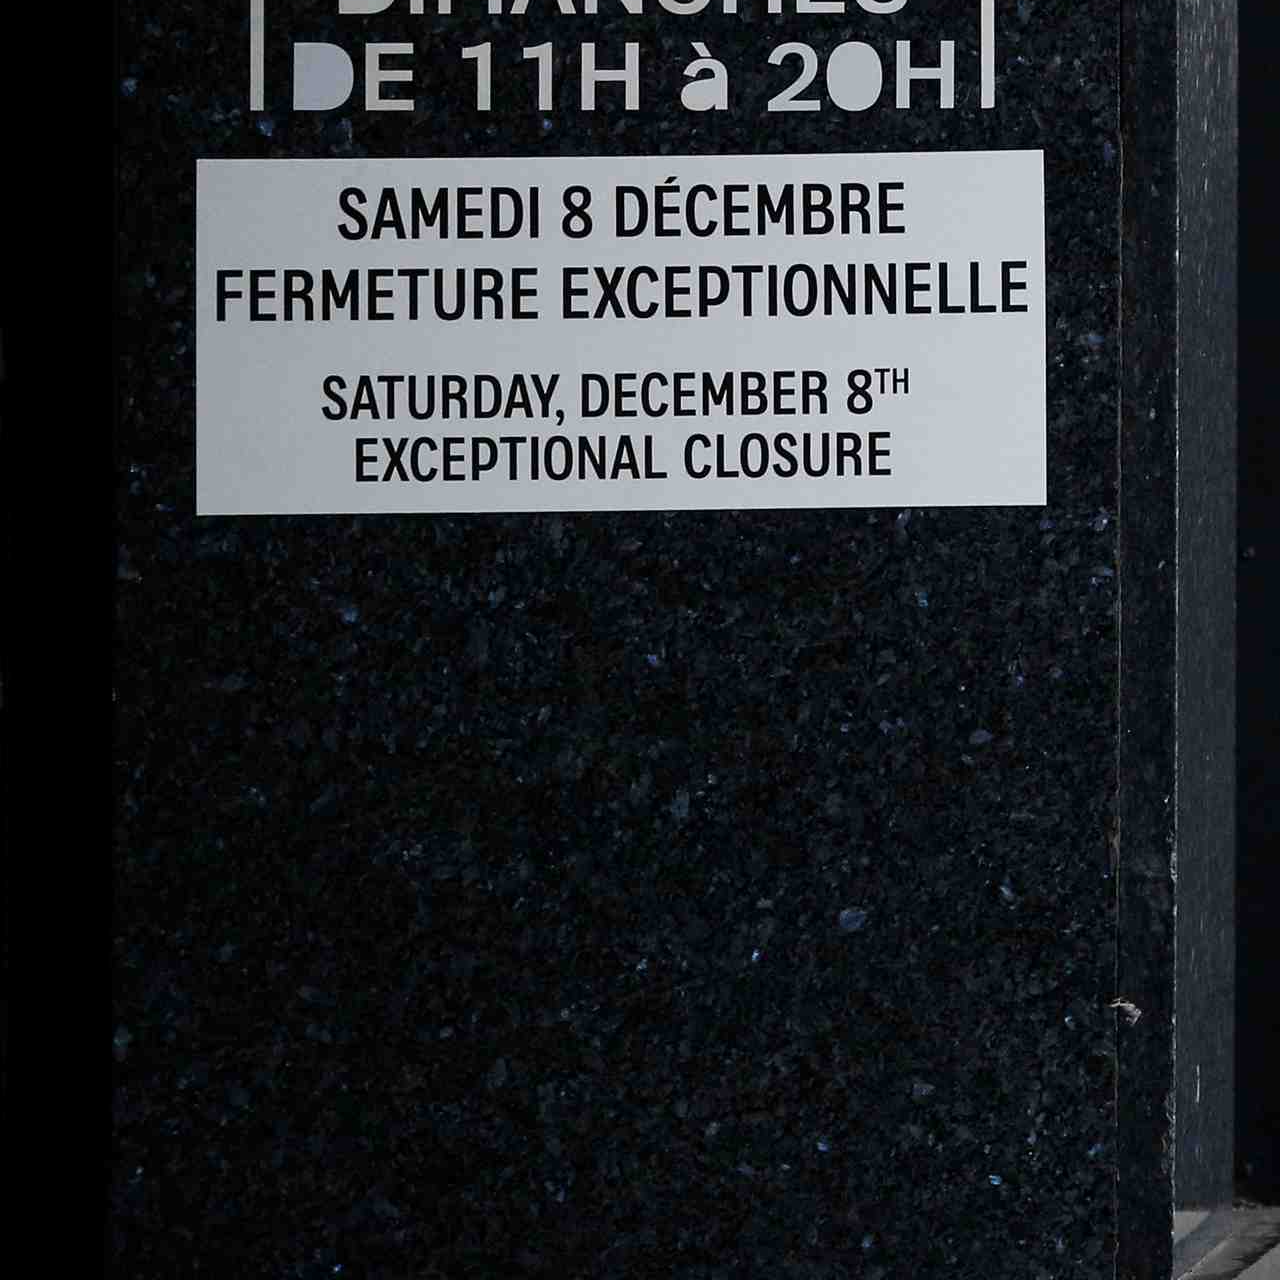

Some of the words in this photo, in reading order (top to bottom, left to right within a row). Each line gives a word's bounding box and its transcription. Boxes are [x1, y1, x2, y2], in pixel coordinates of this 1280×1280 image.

[292, 42, 415, 112] DE
[462, 41, 640, 111] 11H
[680, 41, 729, 112] à
[767, 39, 955, 112] 20H
[337, 186, 539, 241] SAMEDI
[561, 185, 593, 239] 8
[615, 176, 906, 238] DÉCEMBRE
[216, 267, 539, 322] FERMETURE
[562, 260, 1028, 320] EXCEPTIONNELLE
[321, 373, 565, 427] SATURDAY,
[581, 370, 828, 418] DECEMBER
[846, 367, 909, 415] 8TH
[355, 434, 668, 483] EXCEPTIONAL
[684, 431, 892, 479] CLOSURE
